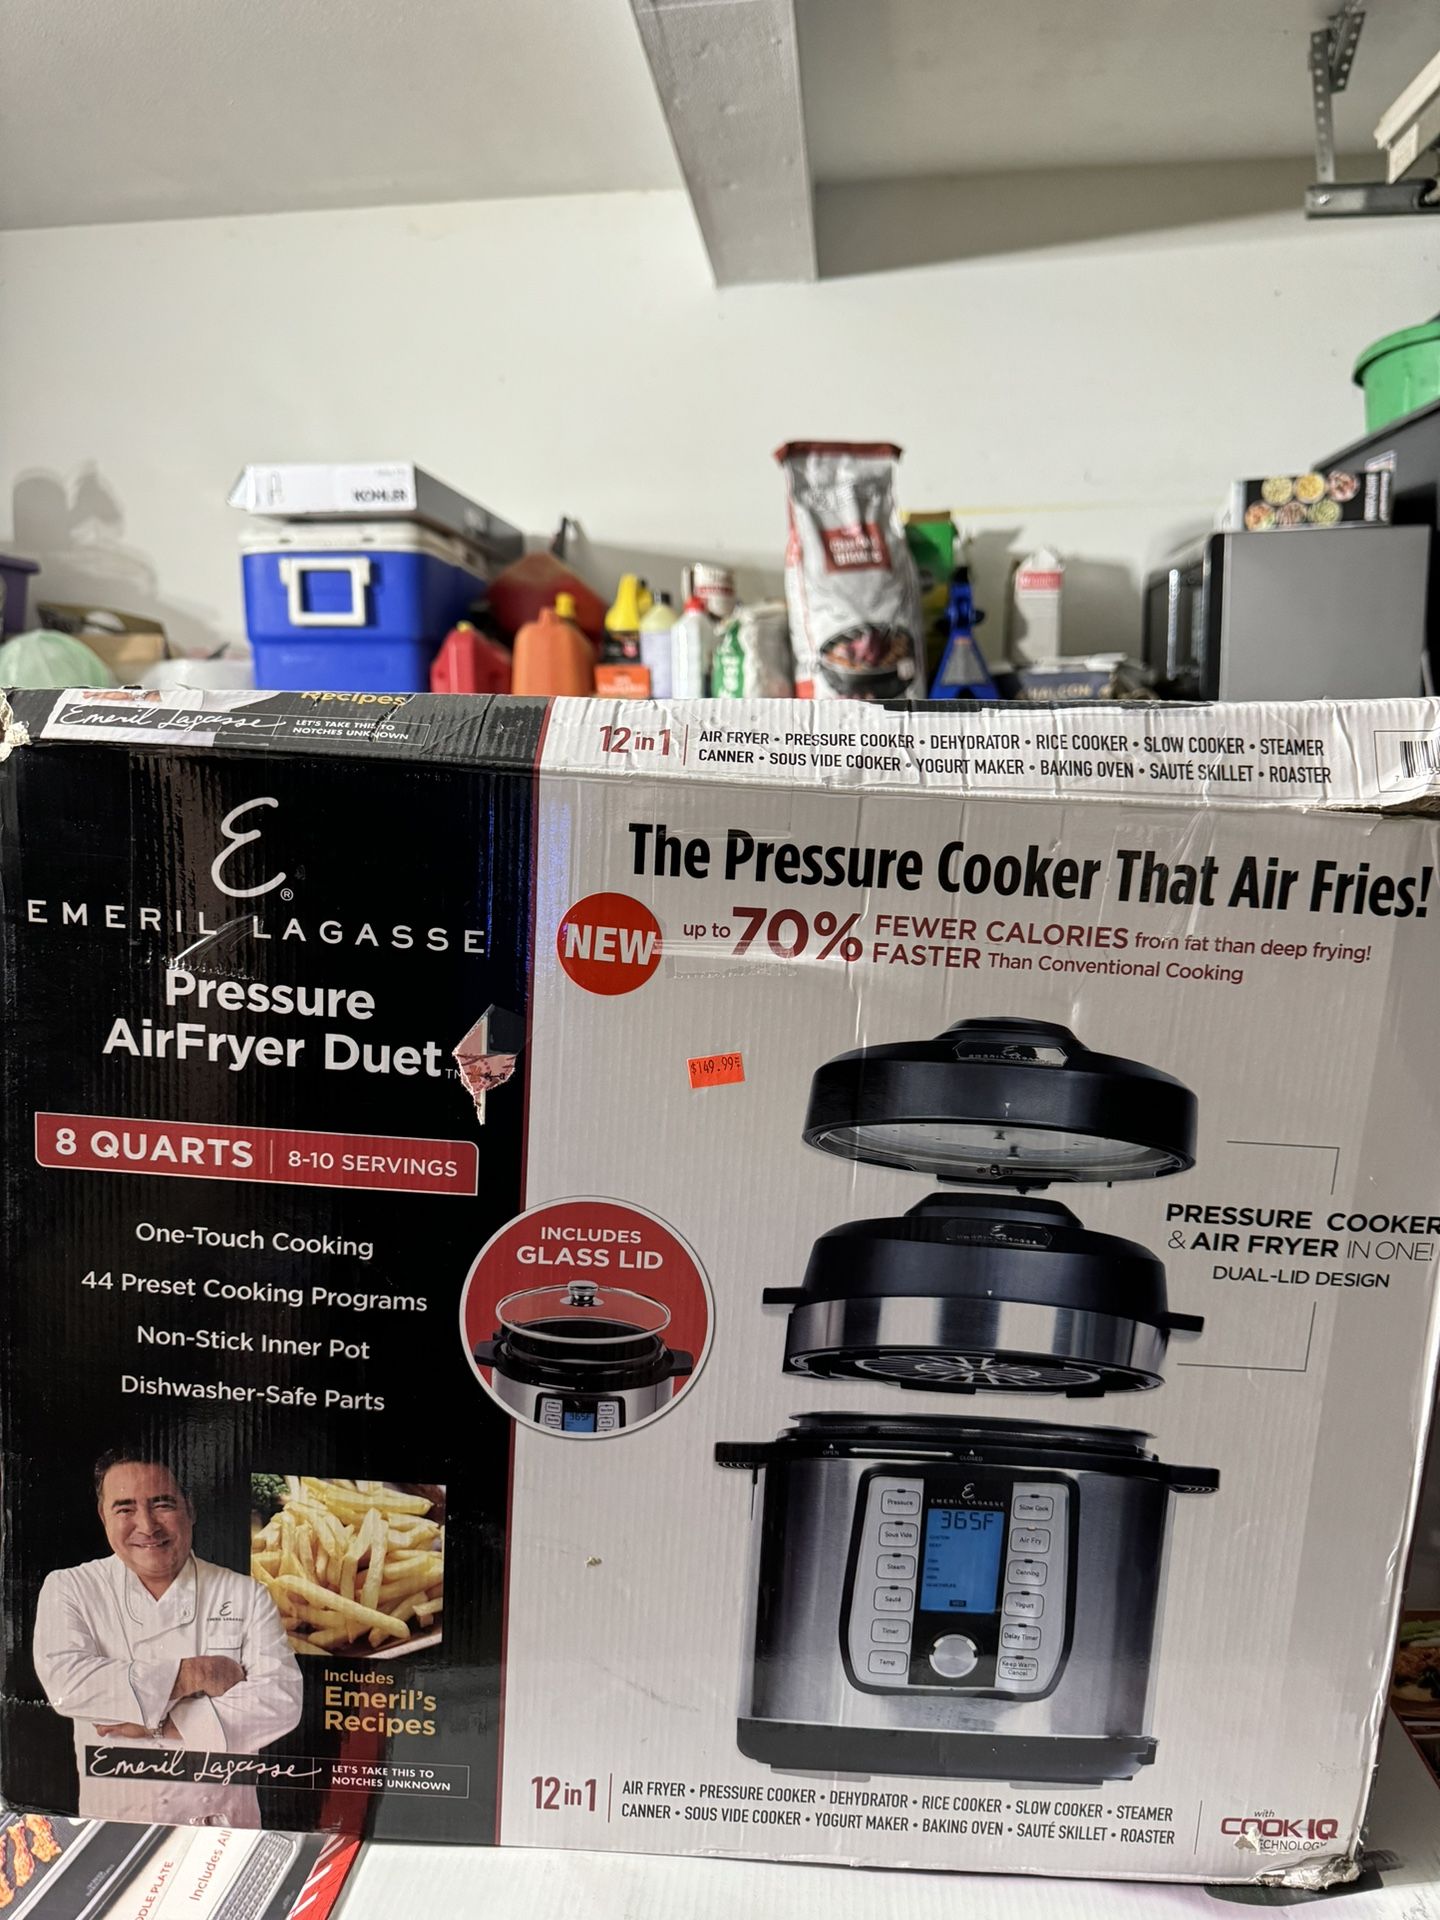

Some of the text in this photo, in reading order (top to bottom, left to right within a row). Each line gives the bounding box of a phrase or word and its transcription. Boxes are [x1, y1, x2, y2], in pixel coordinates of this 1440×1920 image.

[301, 691, 406, 706] Recipes
[60, 704, 286, 732] Emeril Lagasse
[293, 727, 409, 740] NOTCHES UNKNOWN
[296, 719, 321, 727] LET'S
[324, 720, 351, 728] TAKE
[354, 721, 376, 729] THIS
[700, 730, 1325, 756] AIR FRYER PRESSURE COOKER DEHYDRATOR RICE COOKER SLOW COOKER STEAMER
[698, 749, 1332, 784] CANNER SOUS VIDE COOKER YOGURT MAKER BAKING OVEN SAUTÉ SKILLET ROASTER
[628, 822, 1434, 918] The Pressure Cooker That Air Fries!
[27, 900, 486, 954] EMERIL LAGASSE
[683, 906, 863, 963] up to 70%
[875, 914, 1371, 964] FEWER CALORIES from fat than deep frying!
[564, 922, 656, 966] NEW
[873, 942, 1244, 985] FASTER Than Conventional Cooking
[165, 968, 375, 1021] Pressure
[102, 1018, 442, 1078] AirFryer Duet
[55, 1128, 458, 1178] 8 QUARTS 8-10 SERVINGS
[540, 1226, 642, 1244] INCLUDES
[1166, 1203, 1440, 1235] PRESSURE COOKER
[135, 1222, 374, 1260] One-Touch Cooking
[1190, 1232, 1240, 1252] AIR
[1247, 1234, 1339, 1258] FRYER
[1346, 1240, 1371, 1259] IN
[1375, 1240, 1434, 1261] ONE!
[516, 1245, 663, 1270] GLASS LID
[81, 1271, 428, 1312] 44 Preset Cooking Programs
[1212, 1265, 1390, 1288] DUAL-LID DESIGN
[136, 1325, 371, 1360] Non-Stick Inner Pot
[120, 1375, 385, 1411] Dishwasher-Safe Parts
[940, 1510, 994, 1531] 365F
[324, 1669, 394, 1685] Includes
[324, 1686, 437, 1712] Emeril's
[324, 1711, 436, 1736] Recipes
[90, 1745, 322, 1786] Emeril Lagasse
[332, 1764, 434, 1778] LET'S TAKE THIS TO
[332, 1777, 451, 1792] NOTCHES UNKNOWN
[622, 1780, 1173, 1822] AIR FRYER PRESSURE COOKER DEHYDRATOR RICE COOKER SLOW COOKER STEAMER
[1254, 1808, 1275, 1818] with
[621, 1803, 1175, 1845] CANNER SOUS VIDE COOKER YOGURT MAKER BAKING OVEN SAUTÉ SKILLET ROASTER
[1221, 1817, 1339, 1840] COOK IQ
[1259, 1839, 1327, 1851] ECHNOLOGY
[150, 1861, 174, 1893] PLATE
[189, 1829, 233, 1901] Includes All
